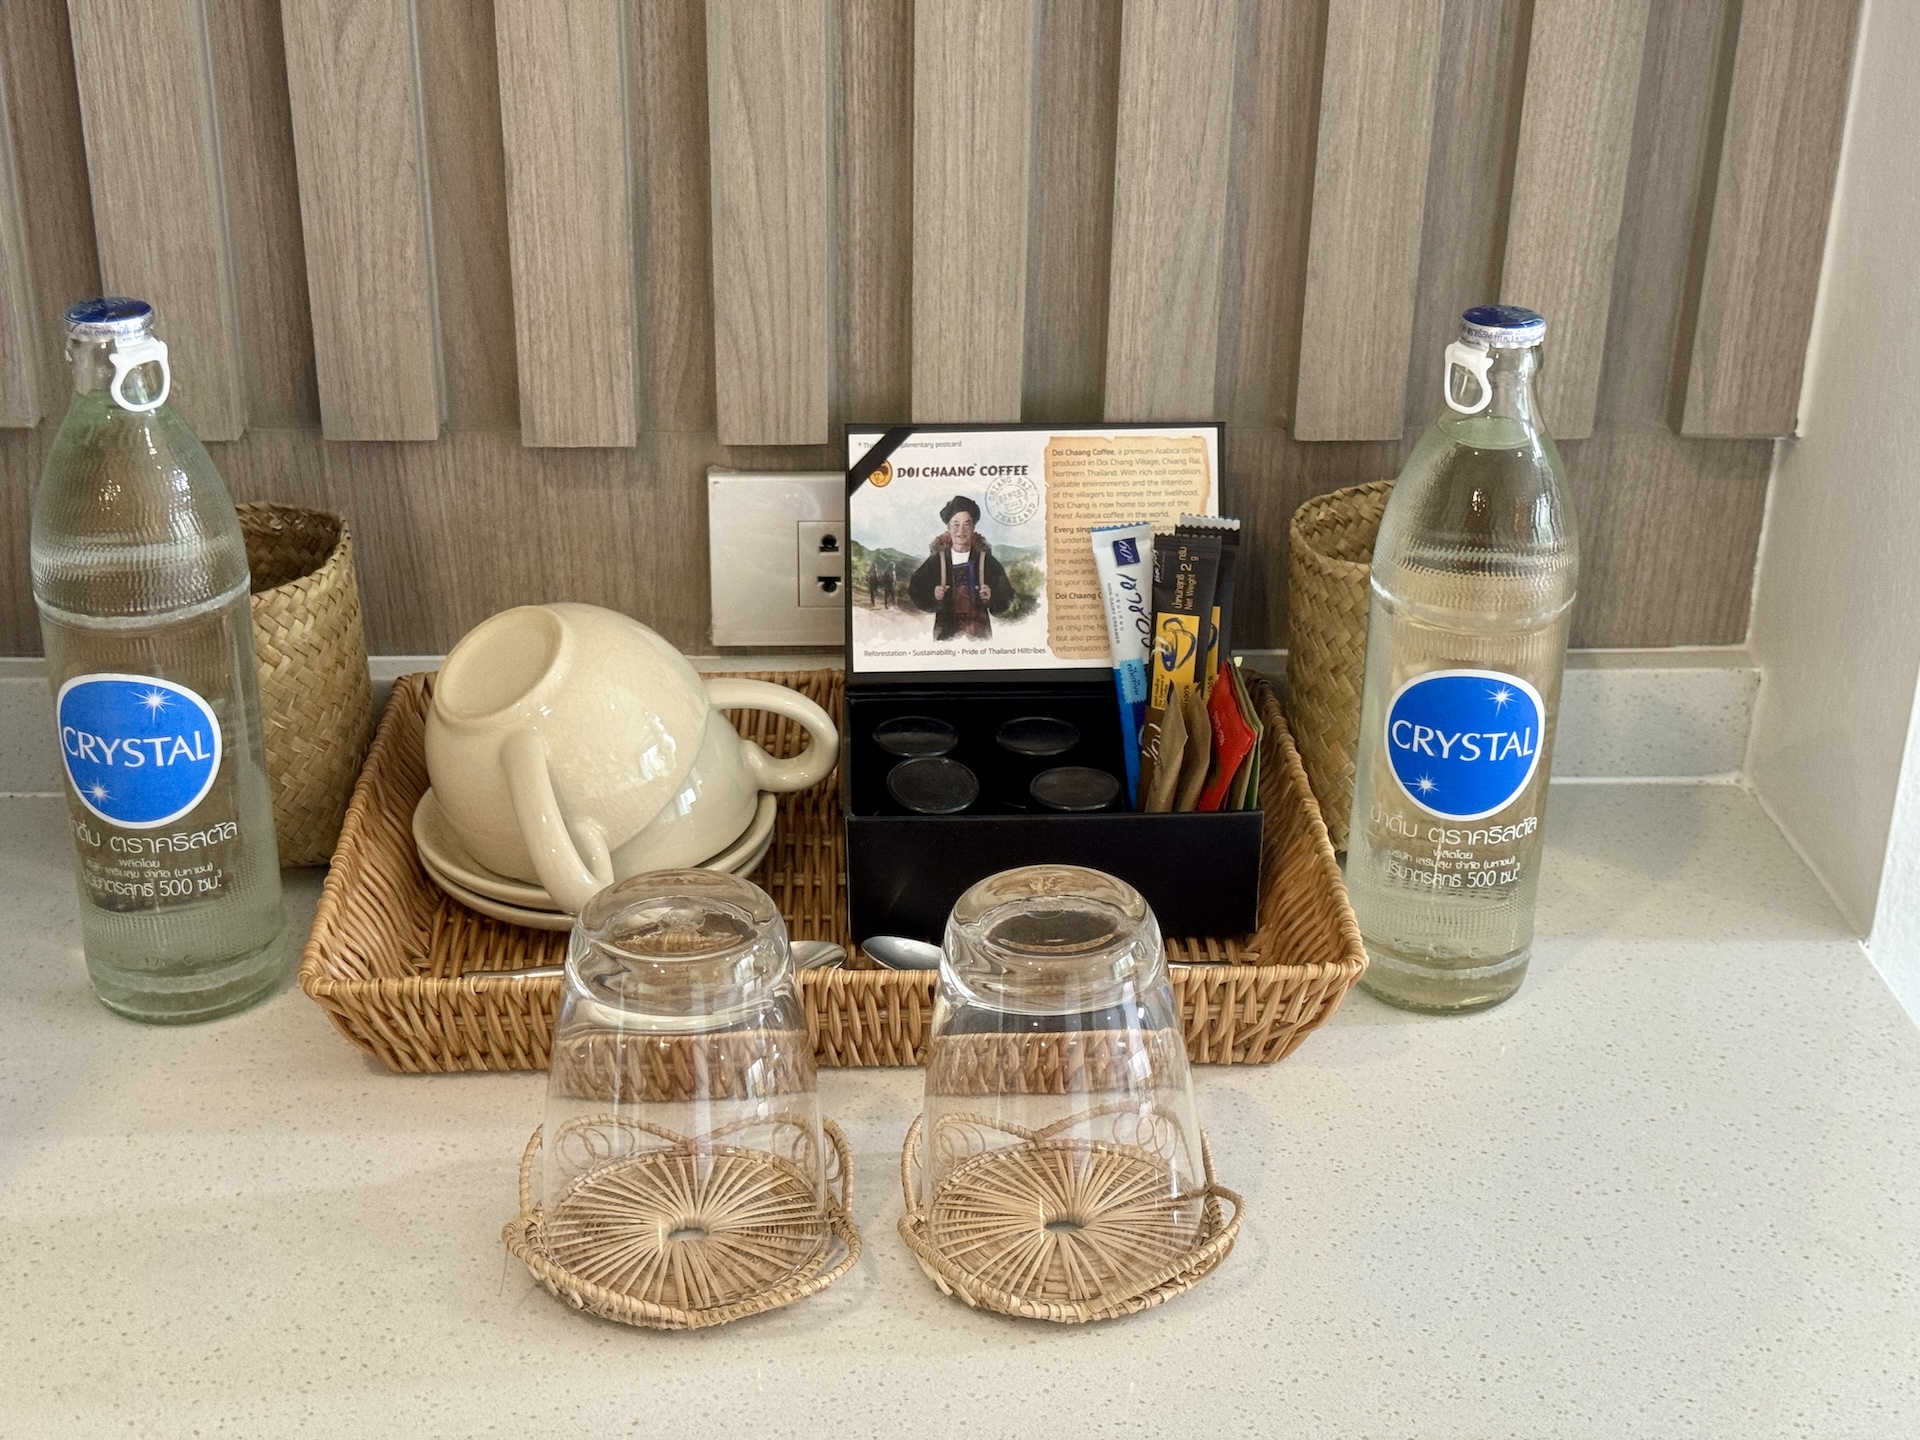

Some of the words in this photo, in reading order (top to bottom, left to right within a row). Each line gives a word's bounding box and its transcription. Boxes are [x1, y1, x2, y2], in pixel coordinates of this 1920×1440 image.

[935, 440, 962, 449] postcard
[1065, 449, 1091, 457] Chaang
[1053, 459, 1086, 467] produced
[1110, 459, 1133, 467] Chang
[1162, 458, 1187, 466] Chiang
[897, 466, 920, 478] DOI
[979, 465, 1028, 476] COFFEE
[1154, 468, 1167, 476] soil
[1053, 480, 1080, 488] suitable
[1147, 479, 1159, 487] the
[1076, 490, 1105, 499] villagers
[1116, 490, 1144, 499] improve
[1067, 501, 1090, 510] Chang
[1053, 512, 1073, 520] finest
[1054, 526, 1074, 534] Every
[1180, 563, 1192, 571] 2
[1055, 568, 1079, 576] unique
[1064, 579, 1081, 587] your
[1186, 573, 1197, 597] Weight
[1069, 592, 1096, 600] Chaang
[1055, 603, 1079, 611] grown
[1184, 597, 1194, 610] Net
[1065, 624, 1081, 632] only
[1112, 616, 1121, 644] CREAMER
[912, 649, 956, 657] Sustainability
[1391, 719, 1534, 762] CRYSTAL
[62, 726, 211, 768] CRYSTAL
[1428, 816, 1538, 846] ตราคริสตัล
[110, 821, 238, 854] ตราคริสตัล
[1467, 870, 1497, 888] 500
[159, 877, 193, 897] 500
